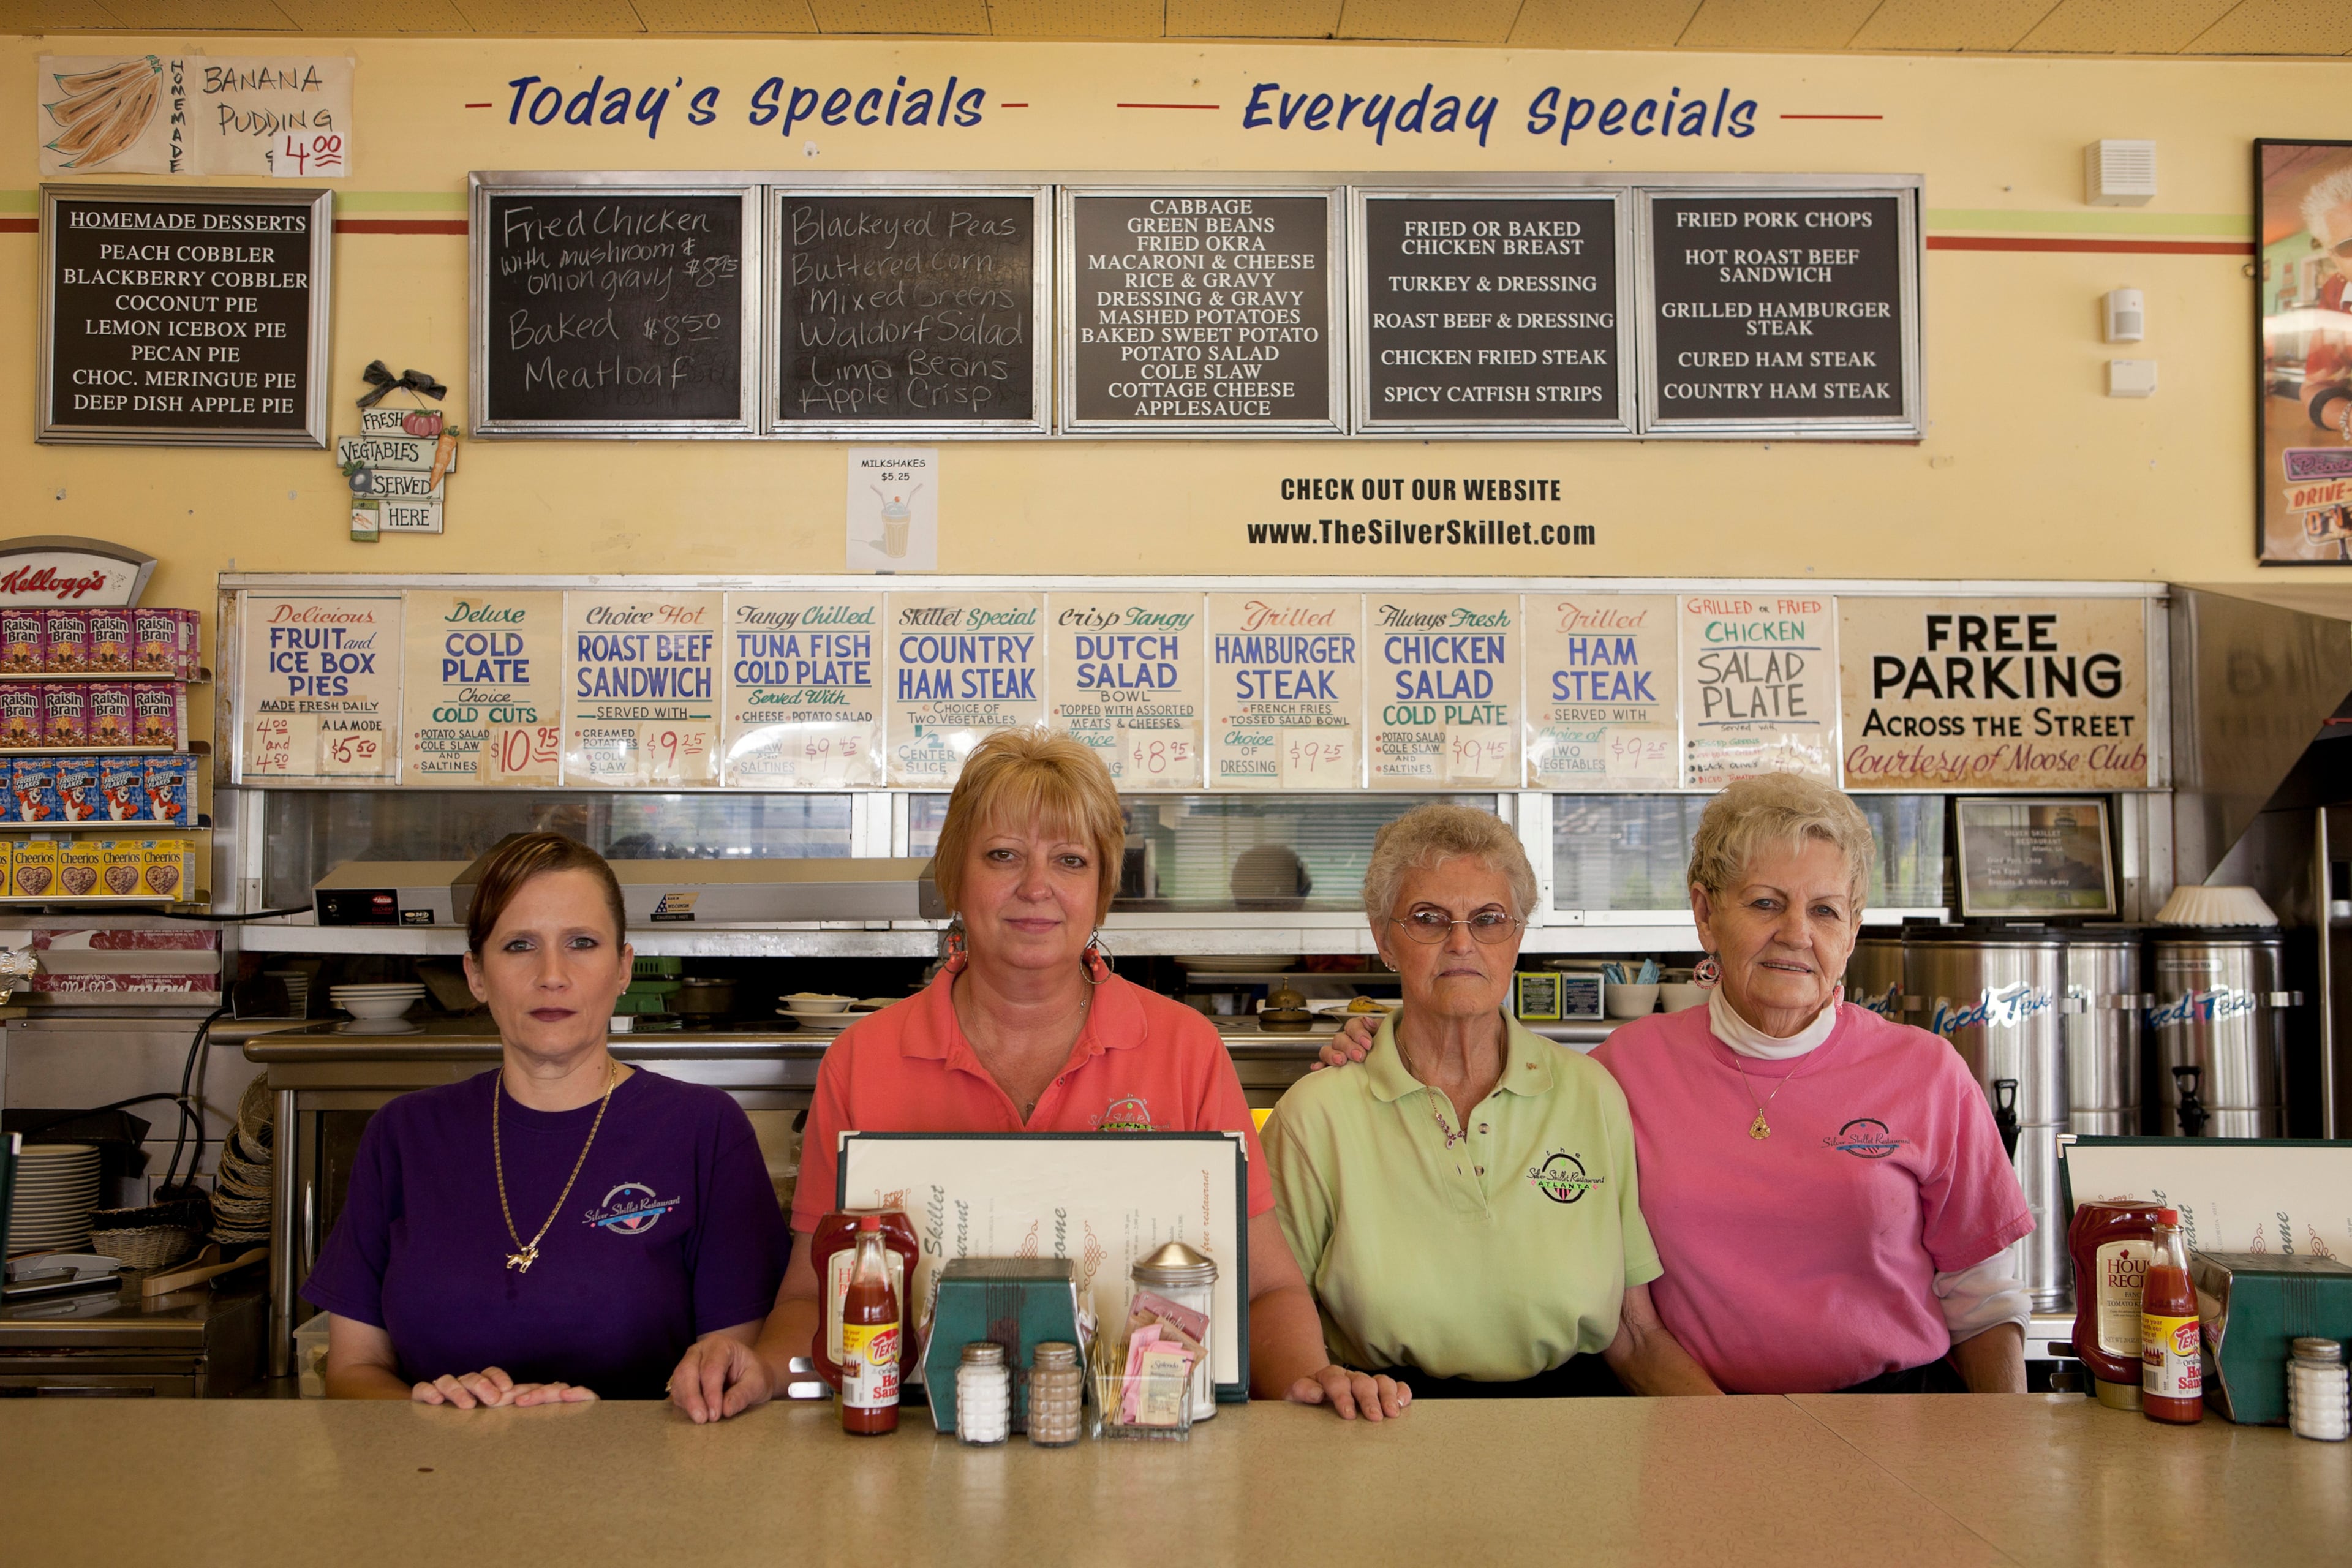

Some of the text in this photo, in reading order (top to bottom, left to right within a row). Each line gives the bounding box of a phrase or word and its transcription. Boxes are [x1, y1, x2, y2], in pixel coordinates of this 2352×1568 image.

[203, 65, 322, 93] BANANA
[170, 60, 185, 173] HOMEMADE
[509, 75, 986, 139] Today's Specials
[1243, 83, 1757, 147] Everyday Specials
[217, 103, 333, 135] PUDDING
[1150, 200, 1252, 215] CABBAGE
[70, 211, 306, 231] HOMEMADE DESSERTS
[504, 207, 712, 247] Fried Chicken
[791, 207, 1016, 248] Blackeyed Peas
[1677, 212, 1872, 227] FRIED PORK CHOPS
[100, 244, 274, 262] PEACH COBBLER
[1088, 254, 1314, 270] MACARONI & CHEESE
[64, 269, 308, 288] BLACKBERRY COBBLER
[528, 268, 673, 301] onion gravy
[1389, 276, 1596, 291] TURKEY & DRESSING
[1662, 302, 1890, 318] GRILLED HAMBURGER
[510, 311, 619, 350] Baked
[1747, 320, 1813, 335] STEAK
[74, 369, 296, 388] CHOC. MERINGUE PIE
[525, 358, 690, 391] Meatloaf
[811, 352, 1008, 386] Lima Beans
[800, 379, 991, 413] Apple Crisp
[1109, 382, 1294, 398] COTTAGE CHEESE
[1385, 386, 1602, 402] SPICY CATFISH STRIPS
[363, 412, 404, 430] FRESH
[341, 442, 419, 462] VEGTABLES
[373, 475, 431, 495] SERVED
[882, 472, 910, 481] $5.25
[1281, 478, 1560, 501] CHECK OUT OUR WEBSITE
[389, 508, 429, 526] HERE
[1248, 519, 1594, 545] www.TheSilverSkillet.com
[1, 565, 106, 599] Kellogg's
[267, 605, 374, 623] Delicious
[445, 601, 525, 623] Deluxe
[586, 605, 707, 625] Choice Hot
[1687, 598, 1752, 614] GRILLED
[1777, 600, 1821, 614] FRIED
[49, 620, 85, 632] Raisin
[137, 619, 174, 631] Raisin
[899, 608, 1037, 631] Skillet Special
[1376, 605, 1510, 631] Always Fresh
[53, 631, 81, 642] Bran
[142, 631, 170, 641] Bran
[271, 628, 377, 649] FRUIT and
[1705, 621, 1804, 643] CHICKEN
[1927, 615, 2057, 652] FREE
[446, 633, 523, 657] COLD
[578, 635, 712, 662] ROAST BEEF
[737, 635, 870, 658] TUNA FISH
[900, 636, 1034, 663] COUNTRY
[1076, 636, 1178, 660] DUTCH
[1216, 636, 1355, 664] HAMBURGER
[1385, 636, 1504, 664] CHICKEN
[1569, 638, 1638, 665] HAM
[270, 652, 375, 674] ICE BOX
[443, 659, 529, 682] PLATE
[734, 660, 870, 684] COLD PLATE
[1698, 650, 1804, 684] SALAD
[288, 676, 348, 696] PIES
[578, 667, 711, 698] SANDWICH
[899, 669, 1036, 699] HAM STEAK
[1077, 663, 1177, 688] SALAD
[1237, 670, 1338, 699] STEAK
[1396, 669, 1493, 699] SALAD
[1553, 671, 1656, 701] STEAK
[1874, 654, 2122, 699] PARKING
[260, 700, 379, 711] MADE FRESH DAILY
[459, 688, 510, 703] Choice
[1101, 690, 1155, 702] BOWL
[1703, 684, 1807, 718] PLATE
[432, 707, 537, 723] COLD CUTS
[1060, 706, 1193, 715] TOPPED WITH ASSORTED
[1251, 704, 1332, 714] FRENCH FRIES
[421, 761, 477, 770] SALTINES
[1221, 760, 1276, 773] DRESSING
[1846, 743, 2147, 783] Courtesy of Moose Club
[60, 774, 86, 785] FROSTED
[61, 780, 83, 790] FLAKES
[16, 853, 54, 863] Cheerios
[61, 853, 99, 863] Cheerios
[104, 853, 140, 862] Cheerios
[145, 852, 180, 862] Cheerios
[2001, 990, 2052, 1020] Tea
[2195, 989, 2253, 1020] Tea
[1821, 1133, 1910, 1148] Silver Skillet Restaurant
[1527, 1167, 1604, 1183] Silver Skillet Restaurant
[582, 1196, 680, 1223] Silver Skillet Restaurant
[924, 1185, 944, 1258] Skillet
[2108, 1259, 2150, 1273] HOUS
